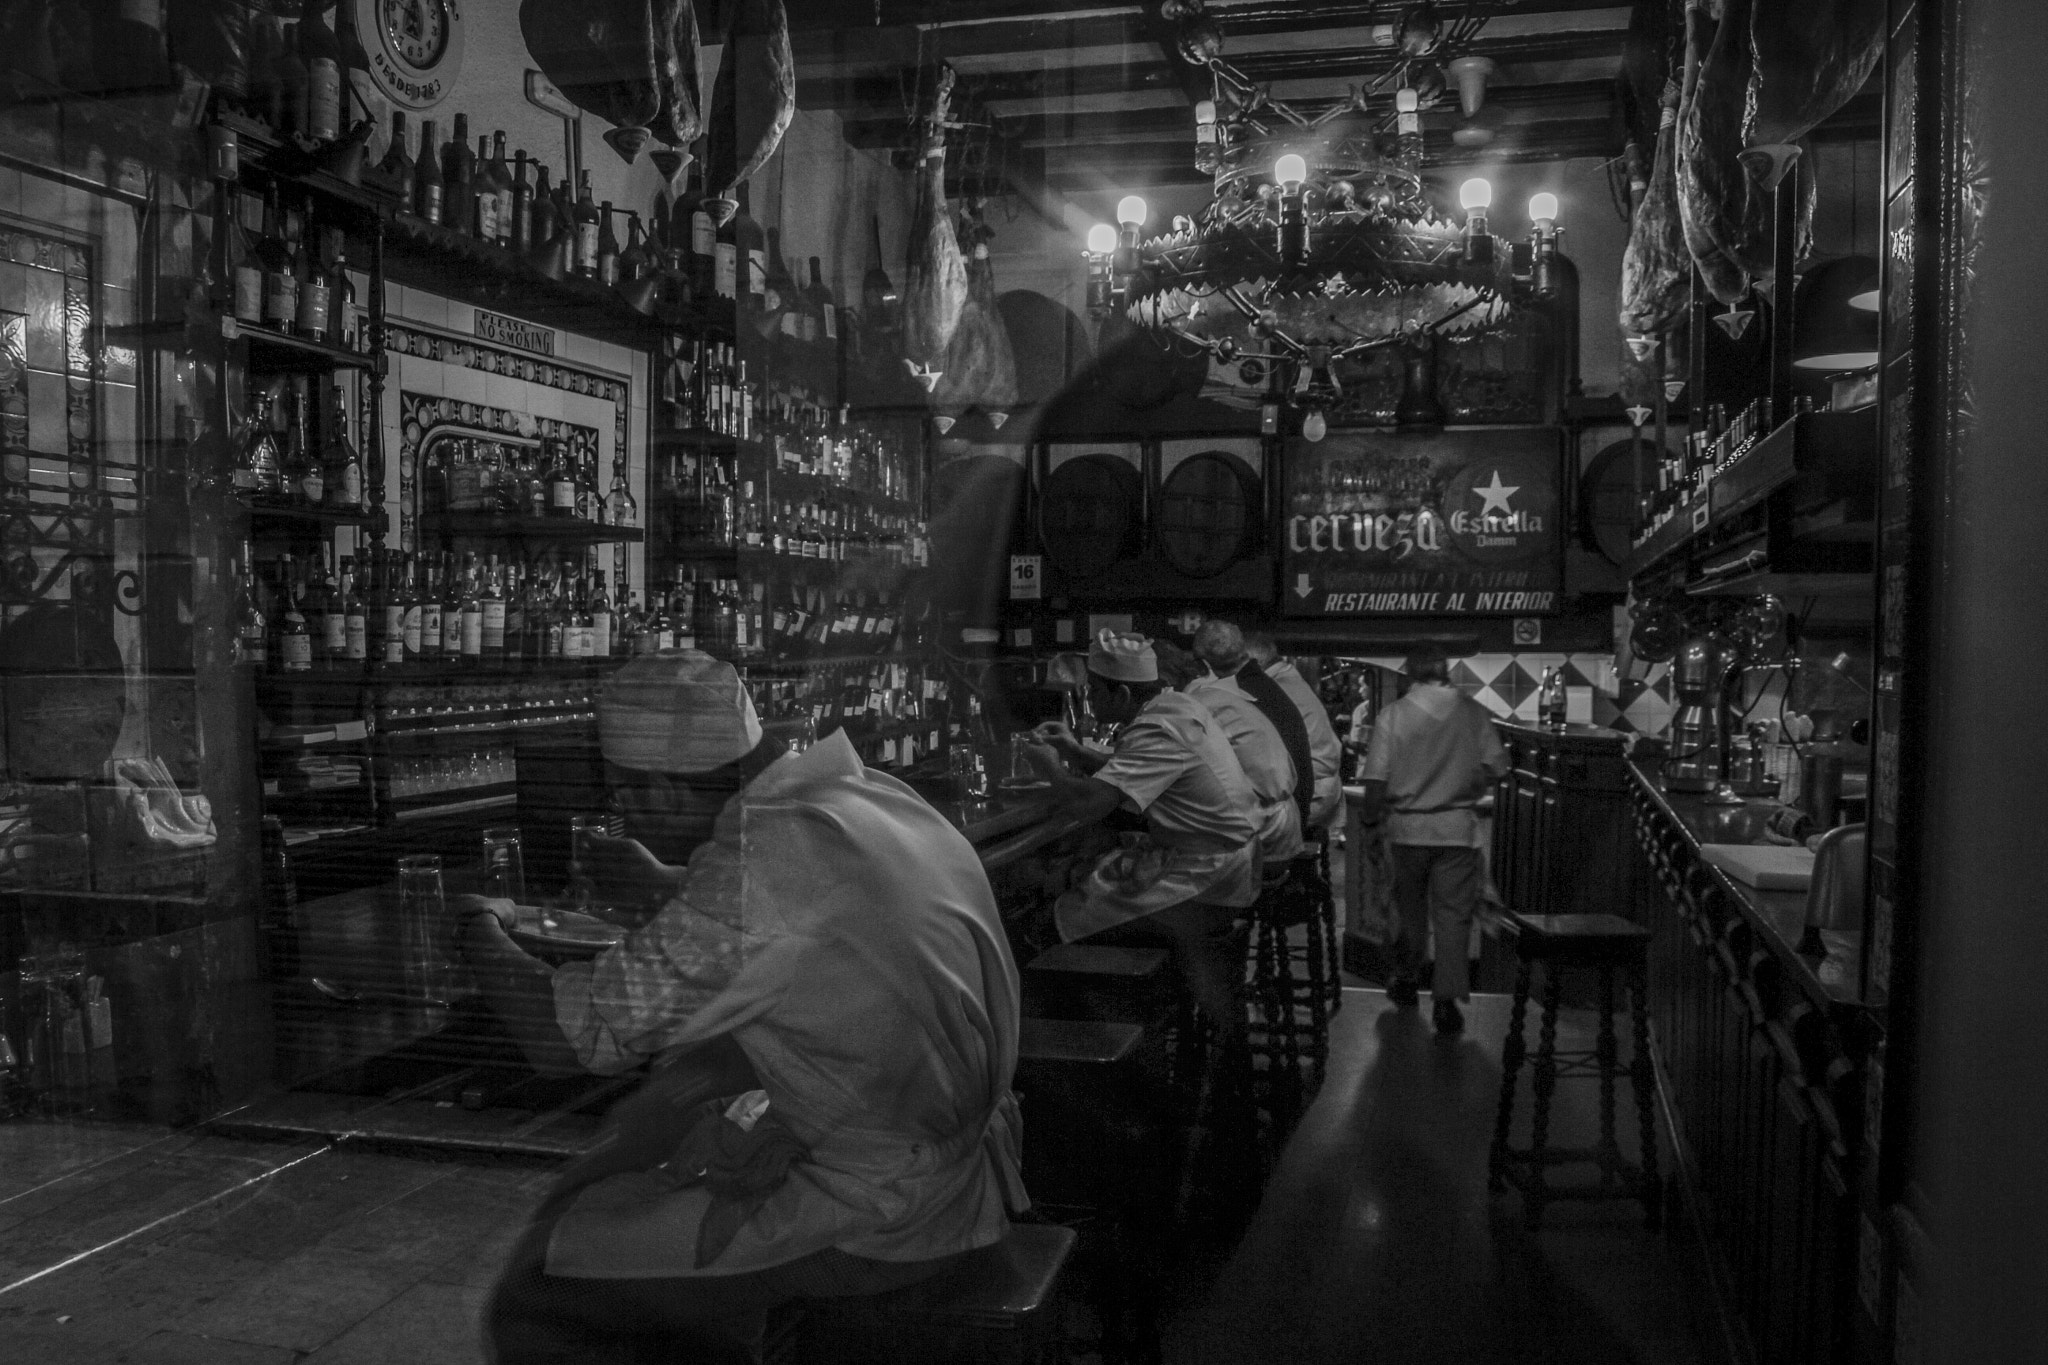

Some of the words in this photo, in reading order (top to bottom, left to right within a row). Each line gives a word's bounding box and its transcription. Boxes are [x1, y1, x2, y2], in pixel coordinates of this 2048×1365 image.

[375, 53, 411, 96] DESDE
[416, 79, 441, 98] 1783
[482, 314, 526, 331] PLEASE
[479, 320, 495, 338] NO
[499, 330, 549, 353] SMOKING
[1288, 508, 1442, 561] cerveza
[1450, 510, 1543, 535] Estrella
[1014, 564, 1034, 579] 16
[1324, 591, 1441, 612] RESTAURANTE
[1444, 592, 1467, 612] AL
[1475, 591, 1555, 611] INTERIOR
